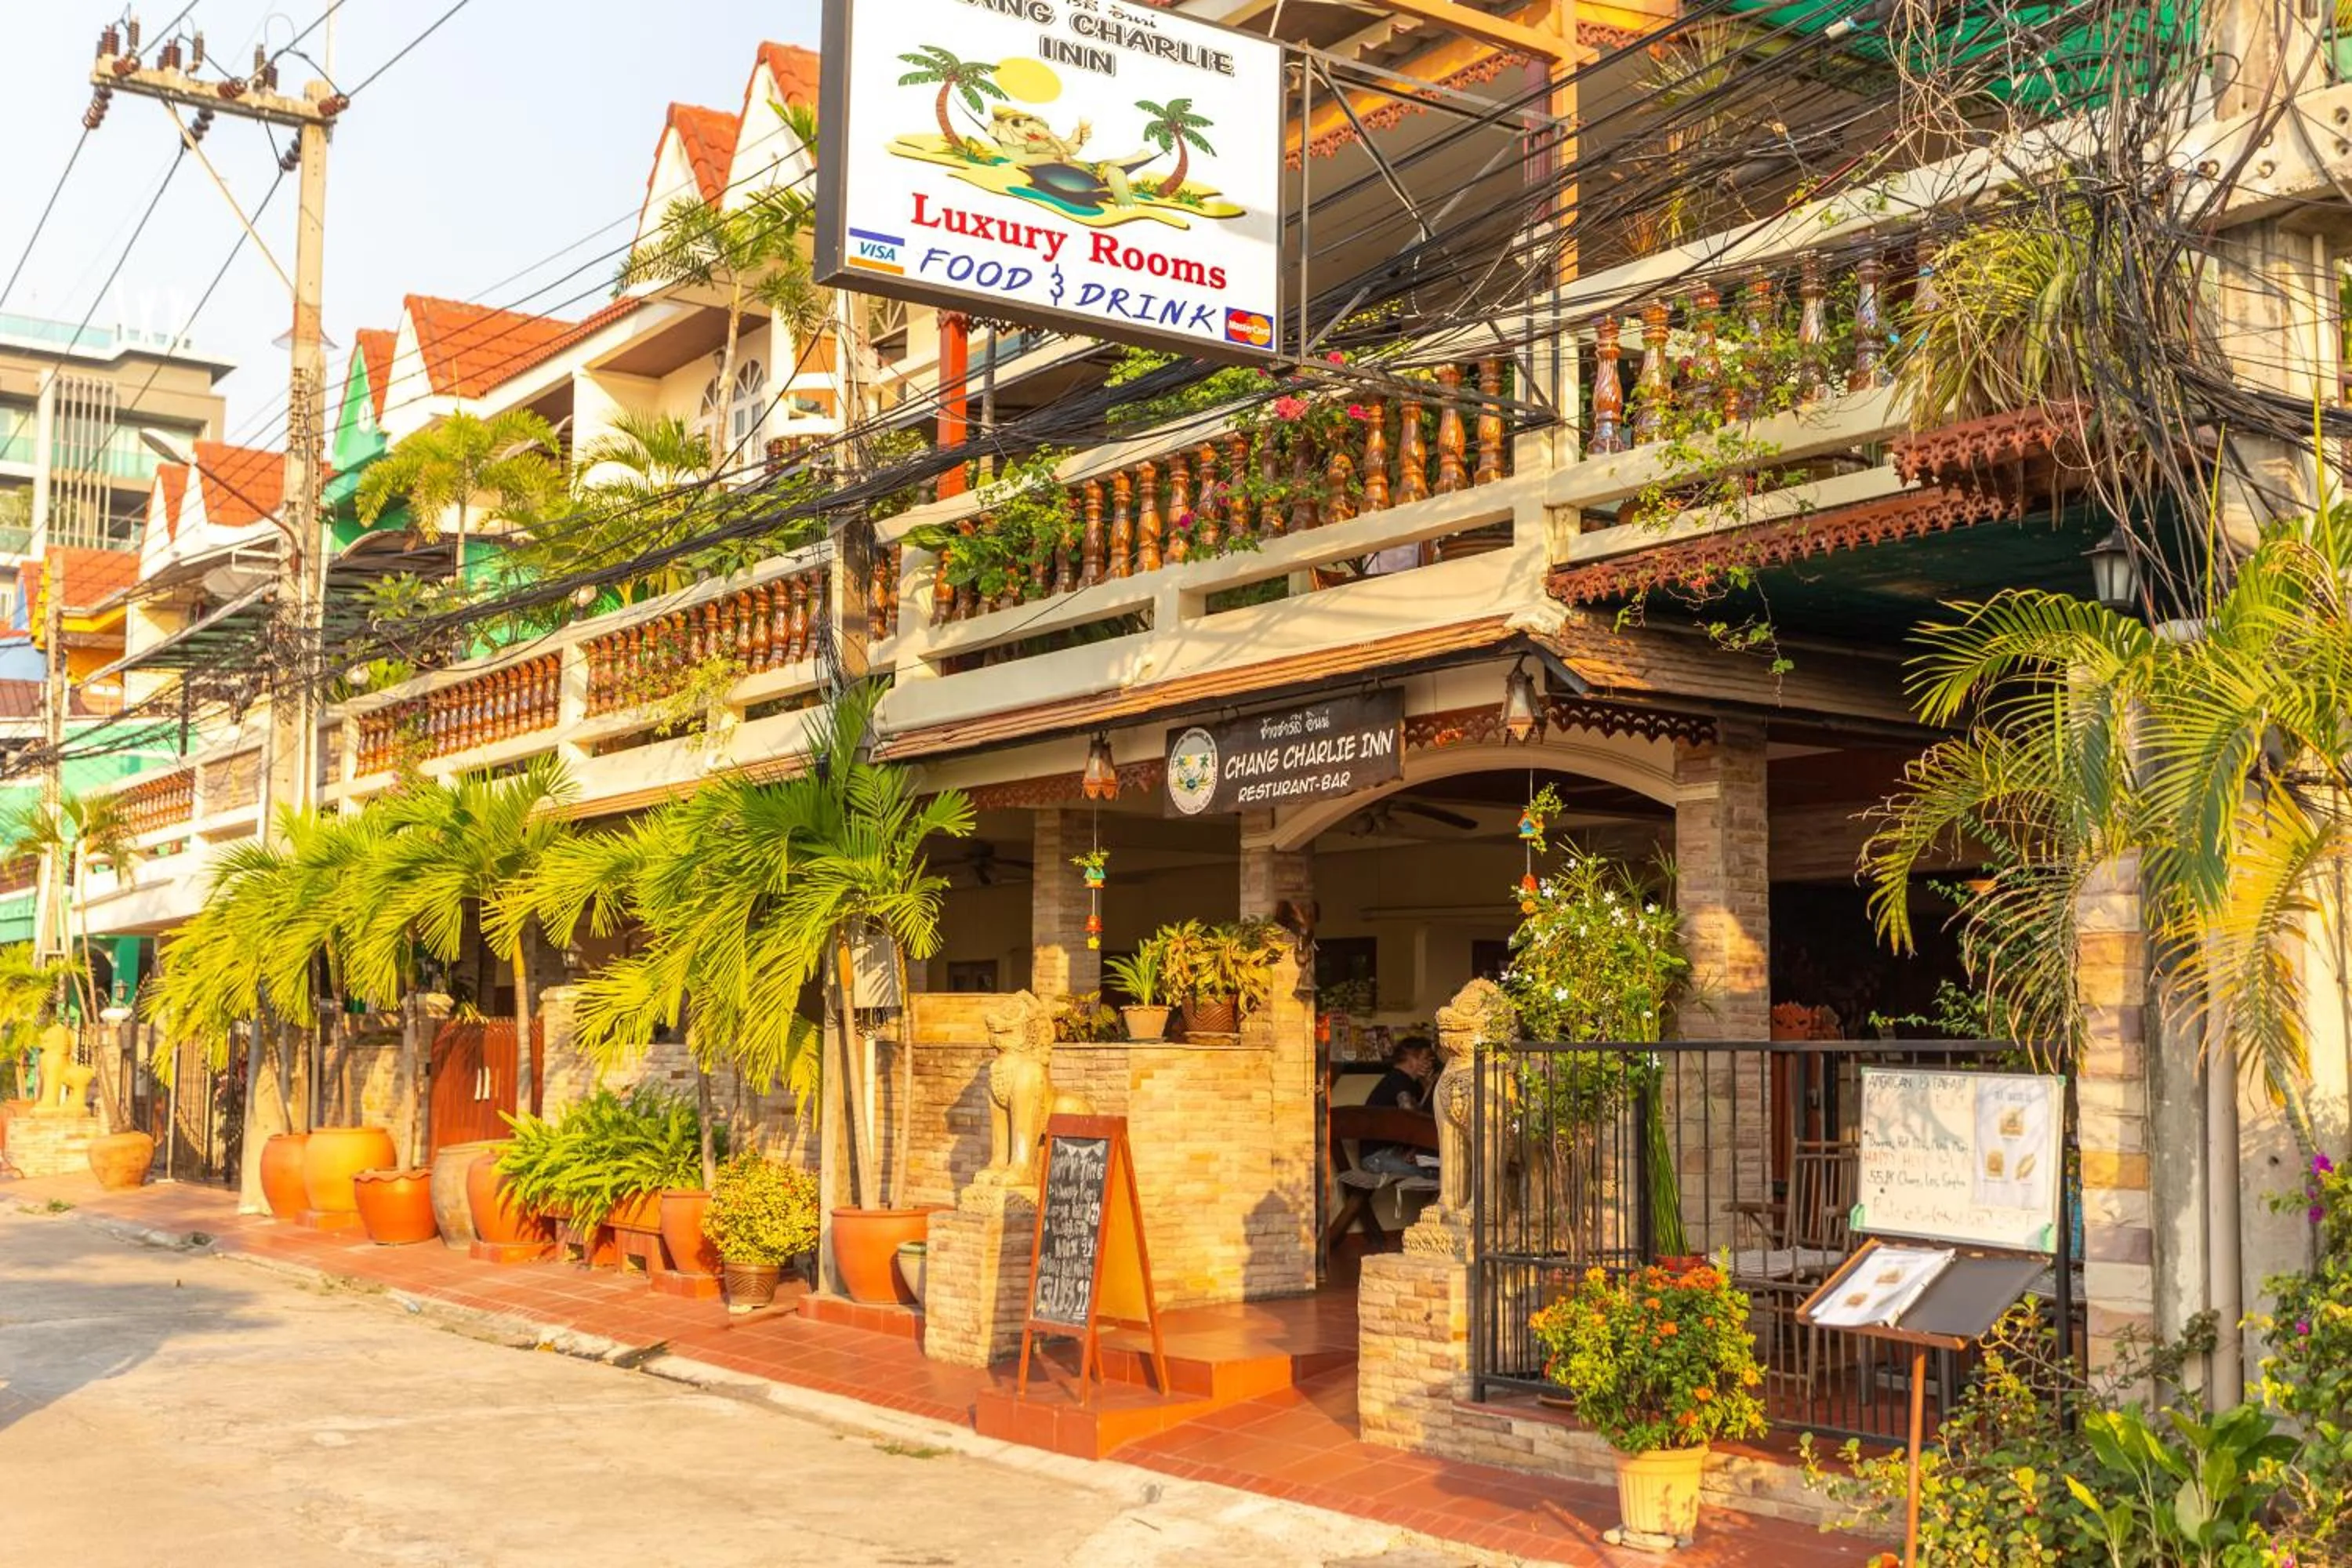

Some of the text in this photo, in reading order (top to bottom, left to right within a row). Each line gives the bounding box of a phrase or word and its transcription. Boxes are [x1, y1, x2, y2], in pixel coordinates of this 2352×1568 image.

[1039, 34, 1116, 77] INN
[1069, 13, 1235, 77] CHARLIE
[859, 241, 896, 262] VISA
[910, 192, 1227, 289] Luxury Rooms
[920, 248, 1033, 291] FOOD
[1075, 283, 1216, 332] DRINK
[1225, 728, 1394, 779] CHANG CHARLIE INN
[1238, 771, 1351, 804] RESTURANT-BAR
